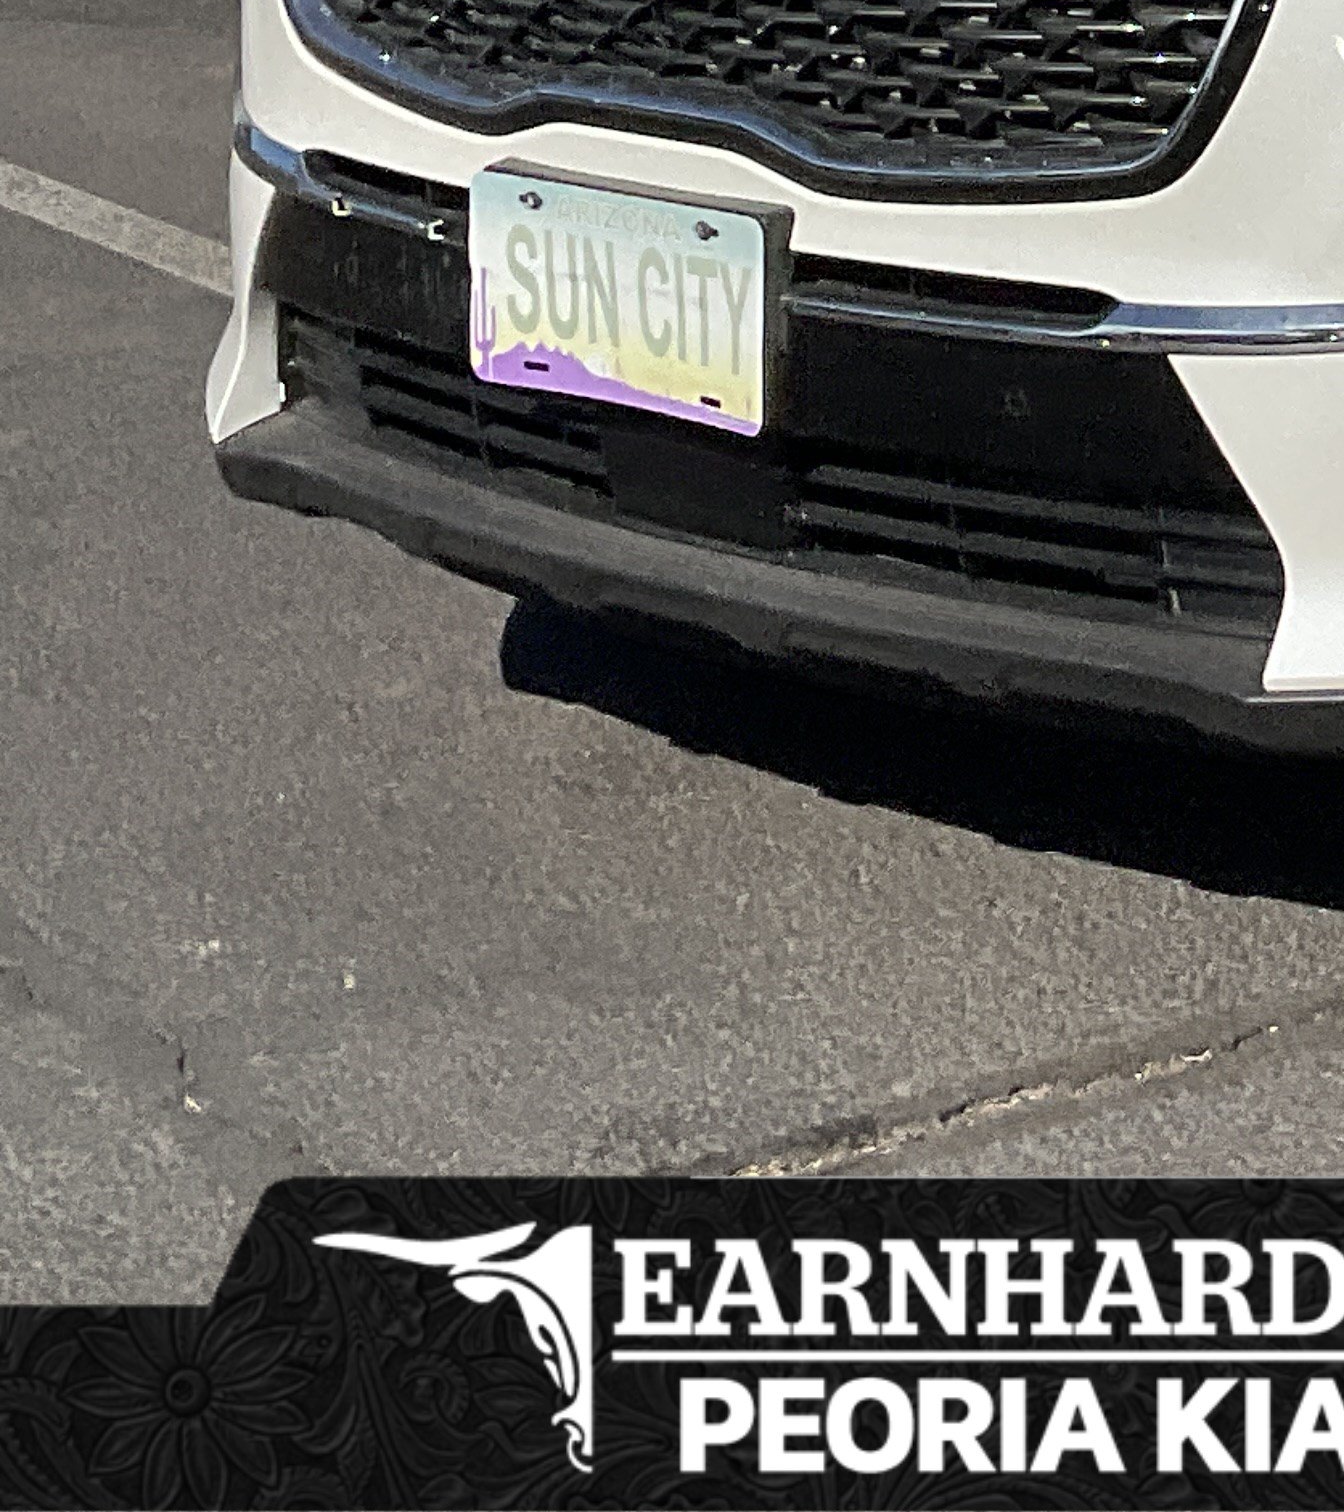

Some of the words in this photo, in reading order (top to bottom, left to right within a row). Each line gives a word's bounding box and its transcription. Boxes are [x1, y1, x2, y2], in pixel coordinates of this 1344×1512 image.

[556, 196, 683, 243] ARIZONA
[506, 224, 620, 349] SUN
[638, 246, 756, 376] CITY
